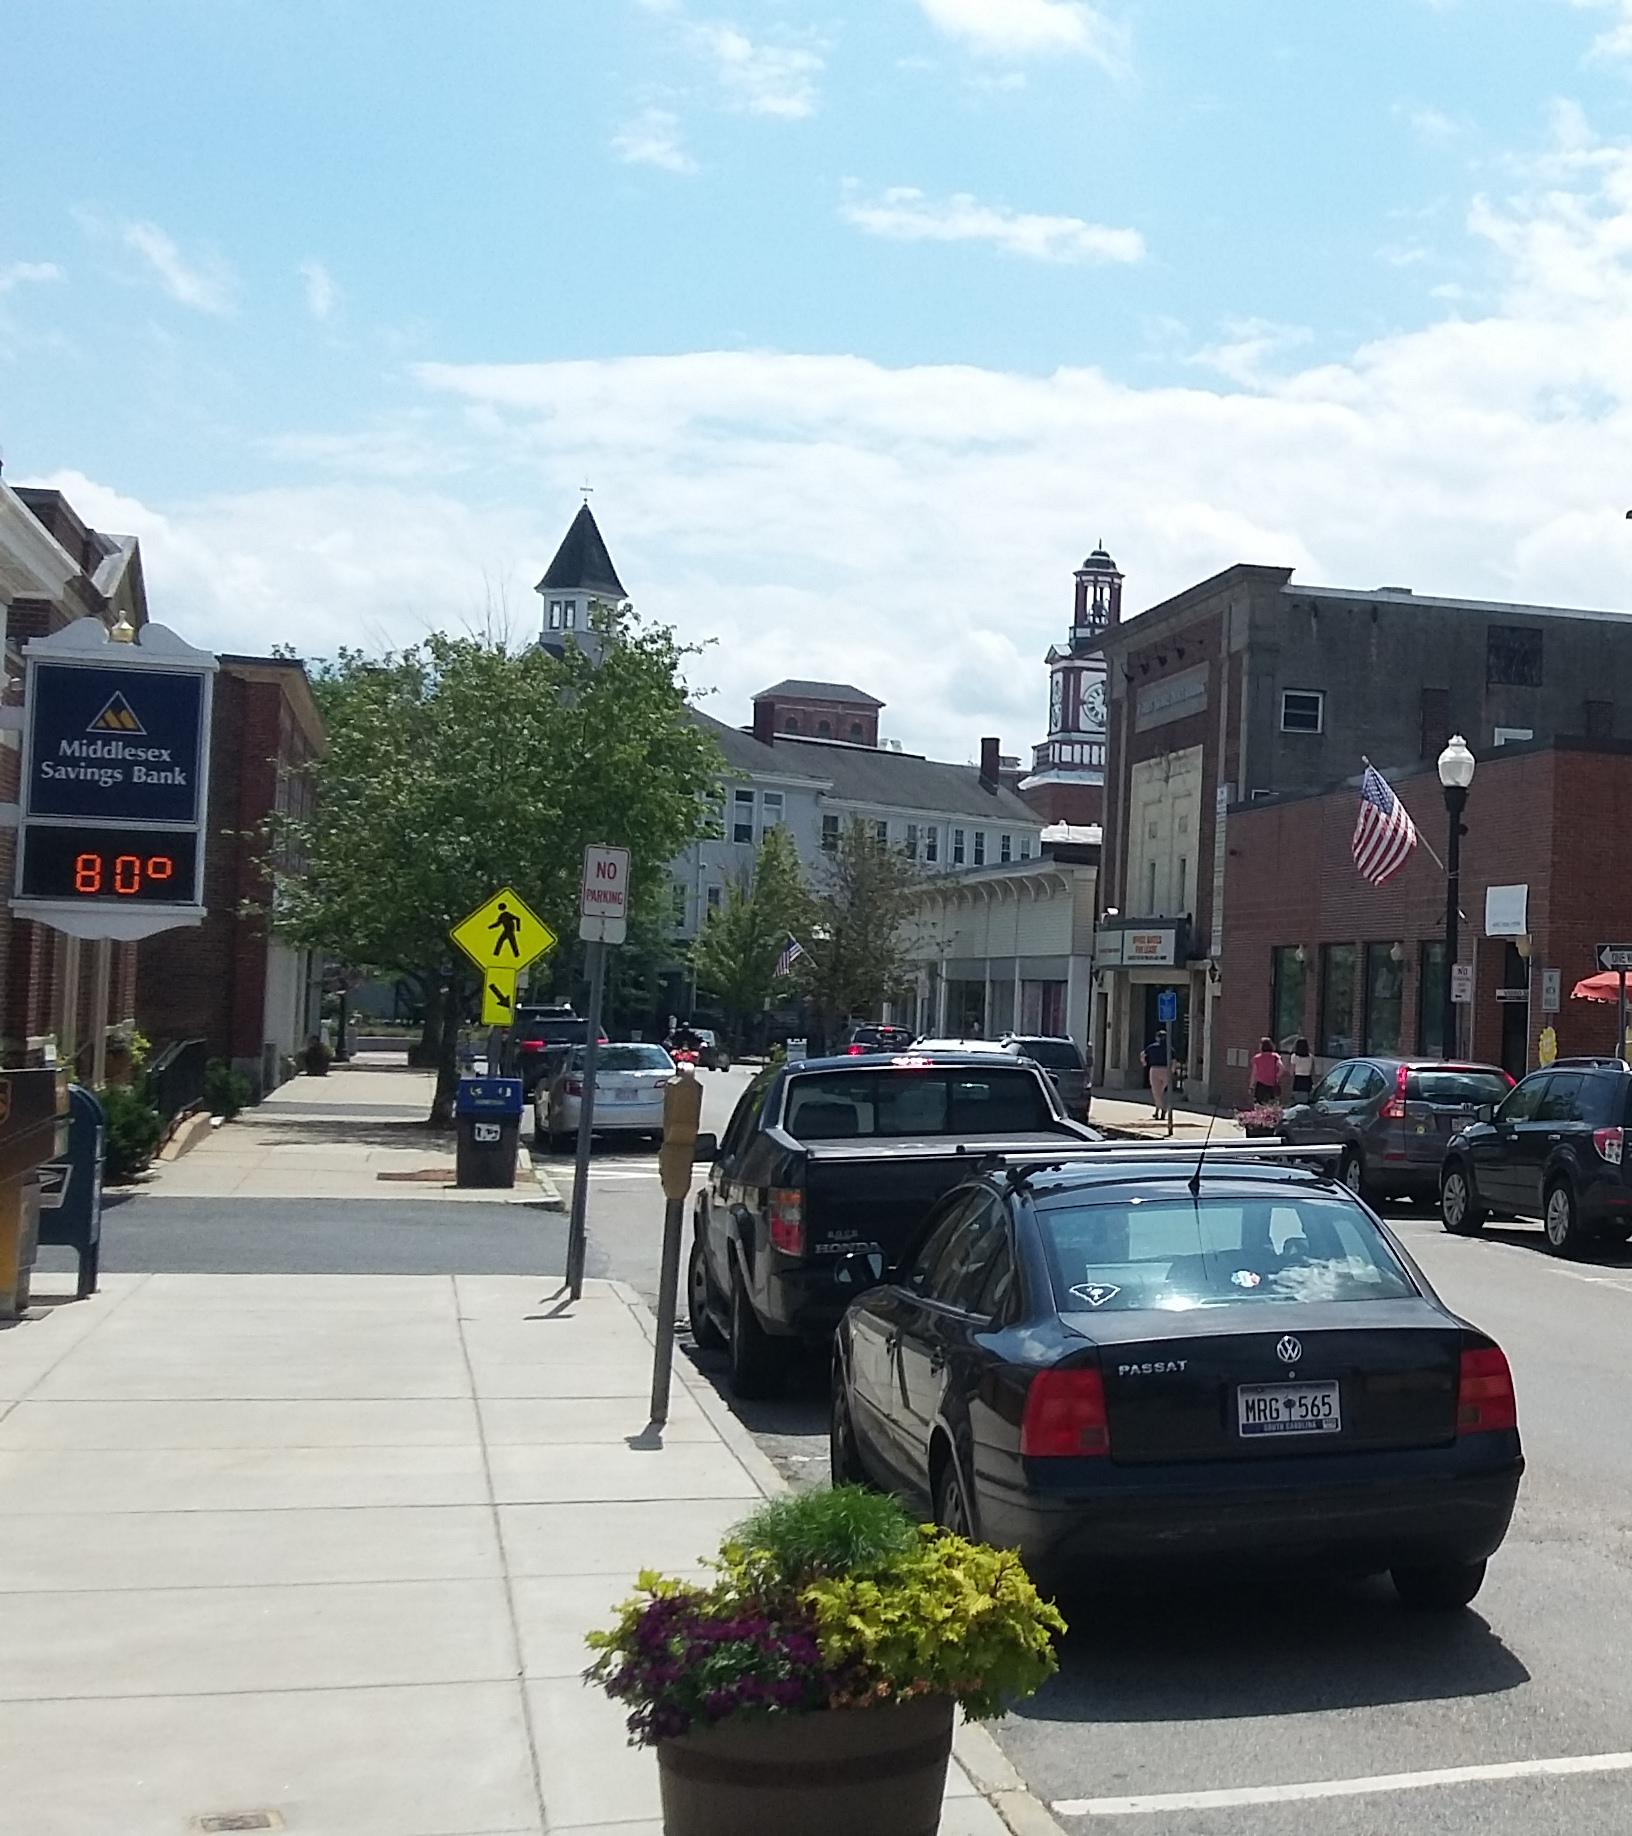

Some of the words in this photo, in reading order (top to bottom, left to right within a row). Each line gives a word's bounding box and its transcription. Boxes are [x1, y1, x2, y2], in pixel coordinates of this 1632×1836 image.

[58, 739, 172, 763] Middlesex
[41, 762, 123, 787] Savings
[132, 766, 187, 786] Bank
[596, 860, 617, 880] NO
[586, 888, 623, 905] PARKING
[1611, 952, 1626, 963] ONE
[1118, 1359, 1188, 1376] PASSAT
[1244, 1397, 1280, 1422] MRG
[1298, 1394, 1332, 1419] 565
